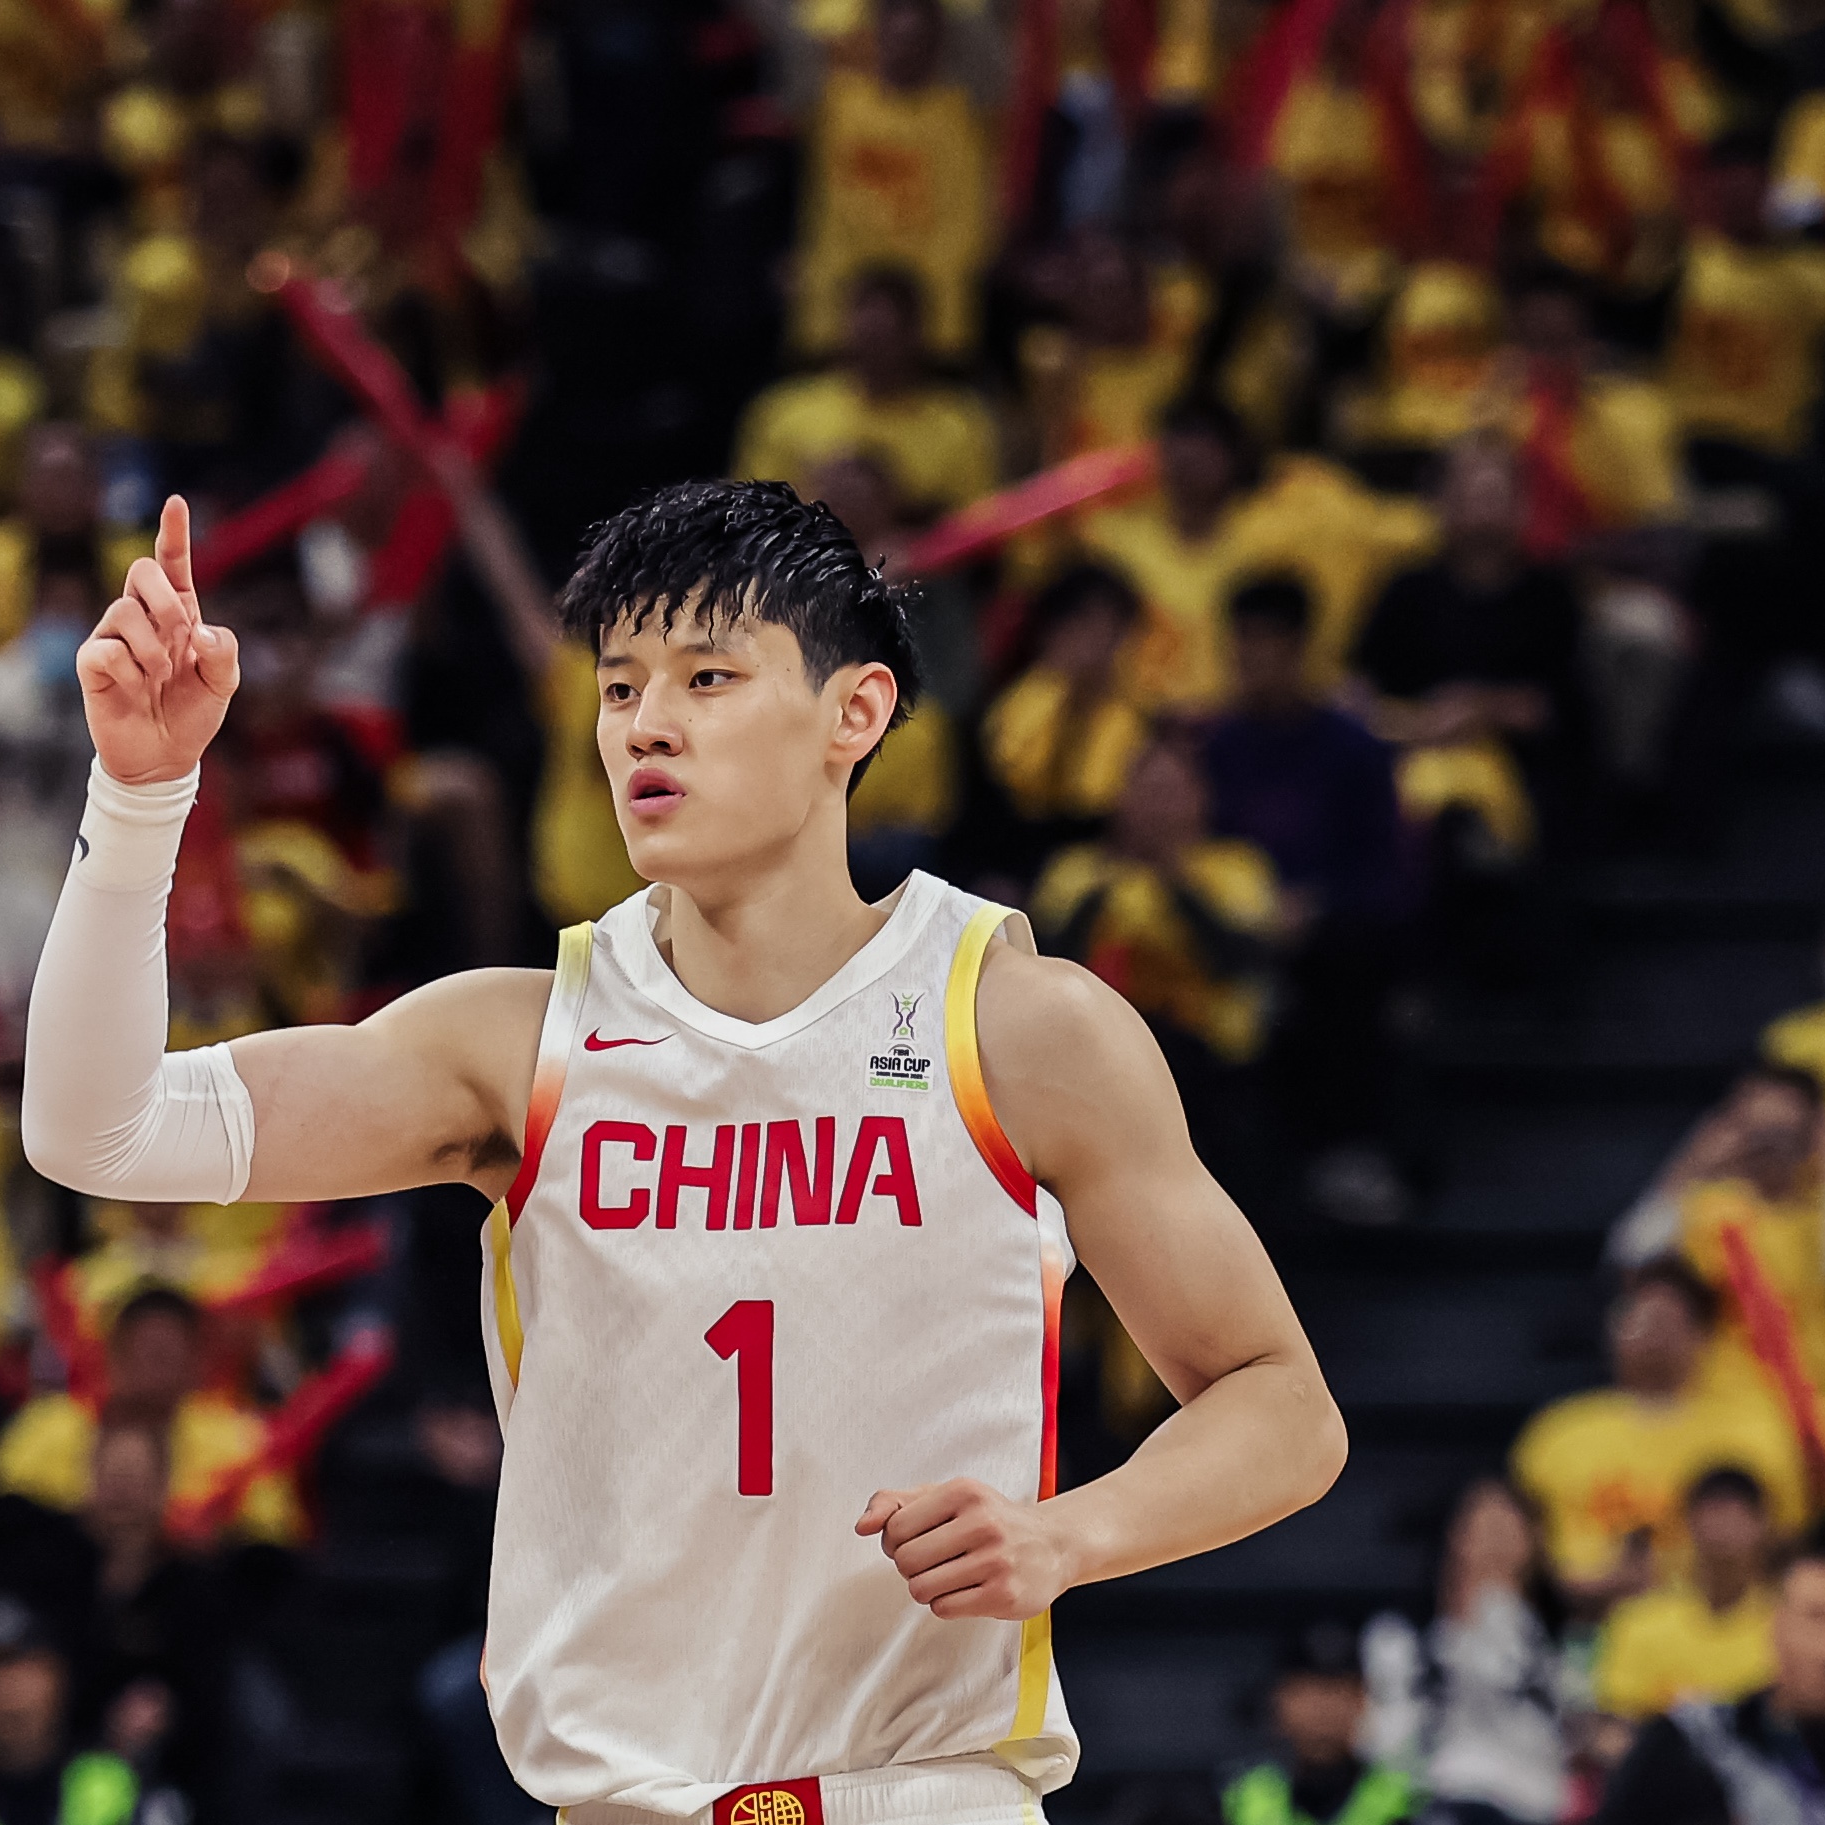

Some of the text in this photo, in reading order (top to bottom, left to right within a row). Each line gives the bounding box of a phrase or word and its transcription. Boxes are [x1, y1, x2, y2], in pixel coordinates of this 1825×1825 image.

[870, 1056, 930, 1072] ASIA CUP
[579, 1116, 923, 1230] CHINA
[704, 1299, 775, 1497] 1
